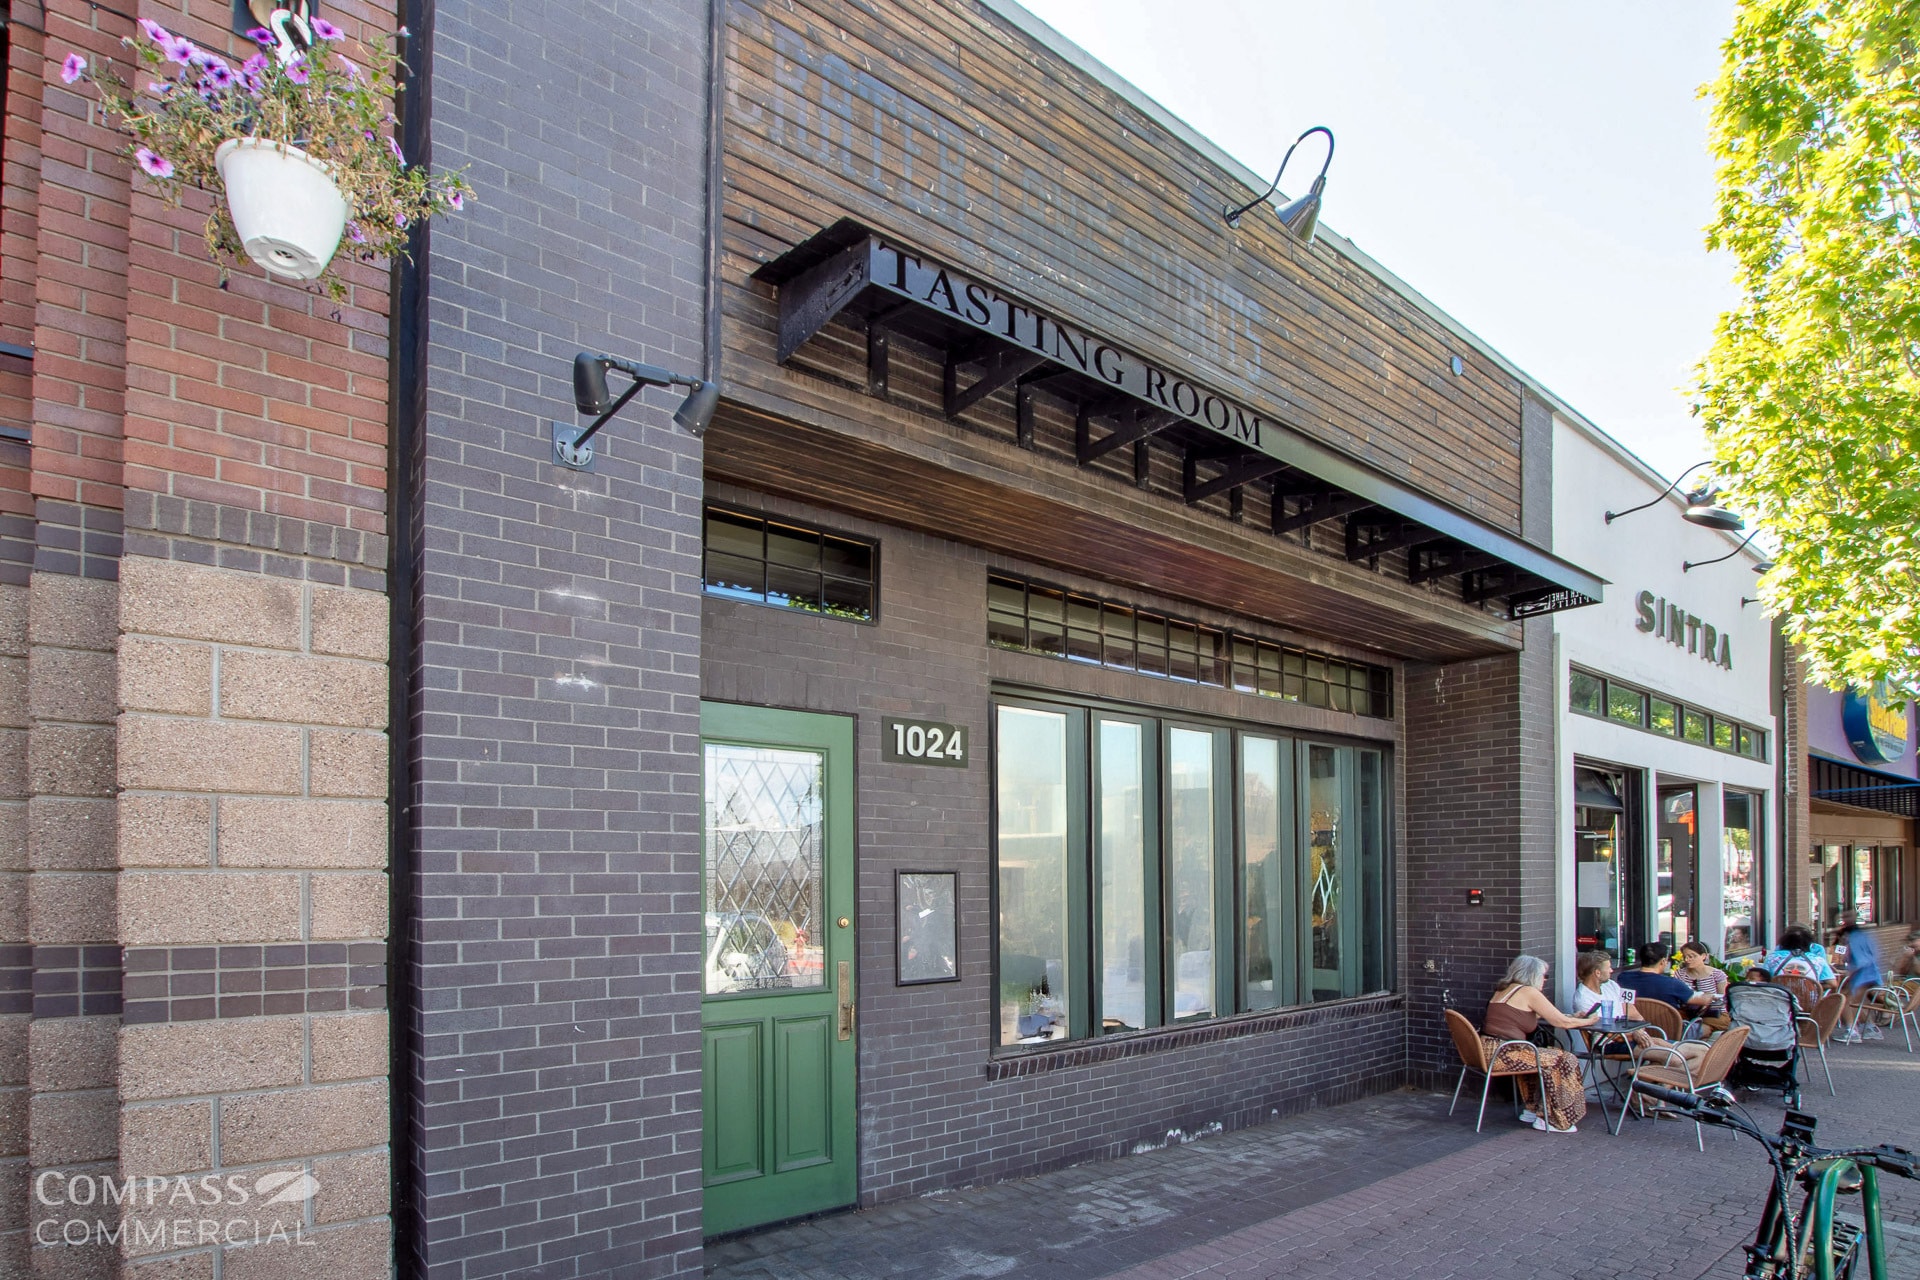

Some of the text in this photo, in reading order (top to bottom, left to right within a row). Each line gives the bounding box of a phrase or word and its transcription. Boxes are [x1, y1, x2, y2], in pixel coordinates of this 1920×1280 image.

[879, 240, 1263, 449] TASTING ROOM
[1635, 590, 1732, 671] SINTRA
[892, 723, 963, 760] 1024
[1621, 991, 1633, 1001] 49
